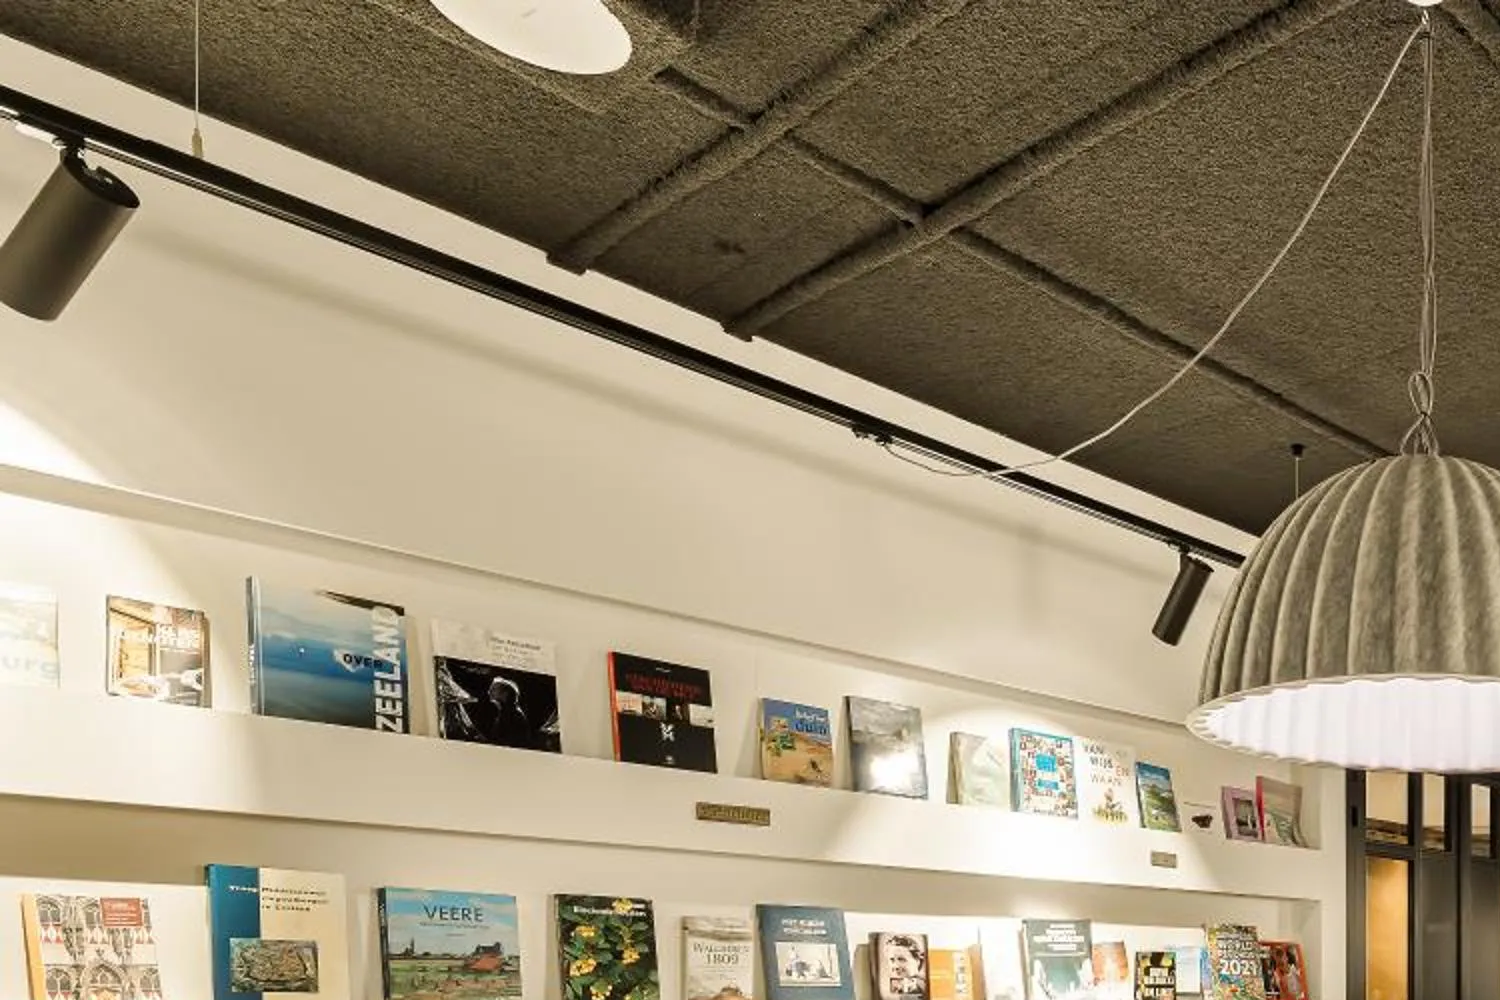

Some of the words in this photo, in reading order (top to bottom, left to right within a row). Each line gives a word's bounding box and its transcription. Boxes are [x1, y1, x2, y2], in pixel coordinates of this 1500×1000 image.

[343, 653, 384, 669] OVER
[372, 606, 404, 734] ZEELAND
[423, 904, 485, 923] VEERE
[705, 953, 740, 965] 1809
[1219, 958, 1258, 976] 2021
